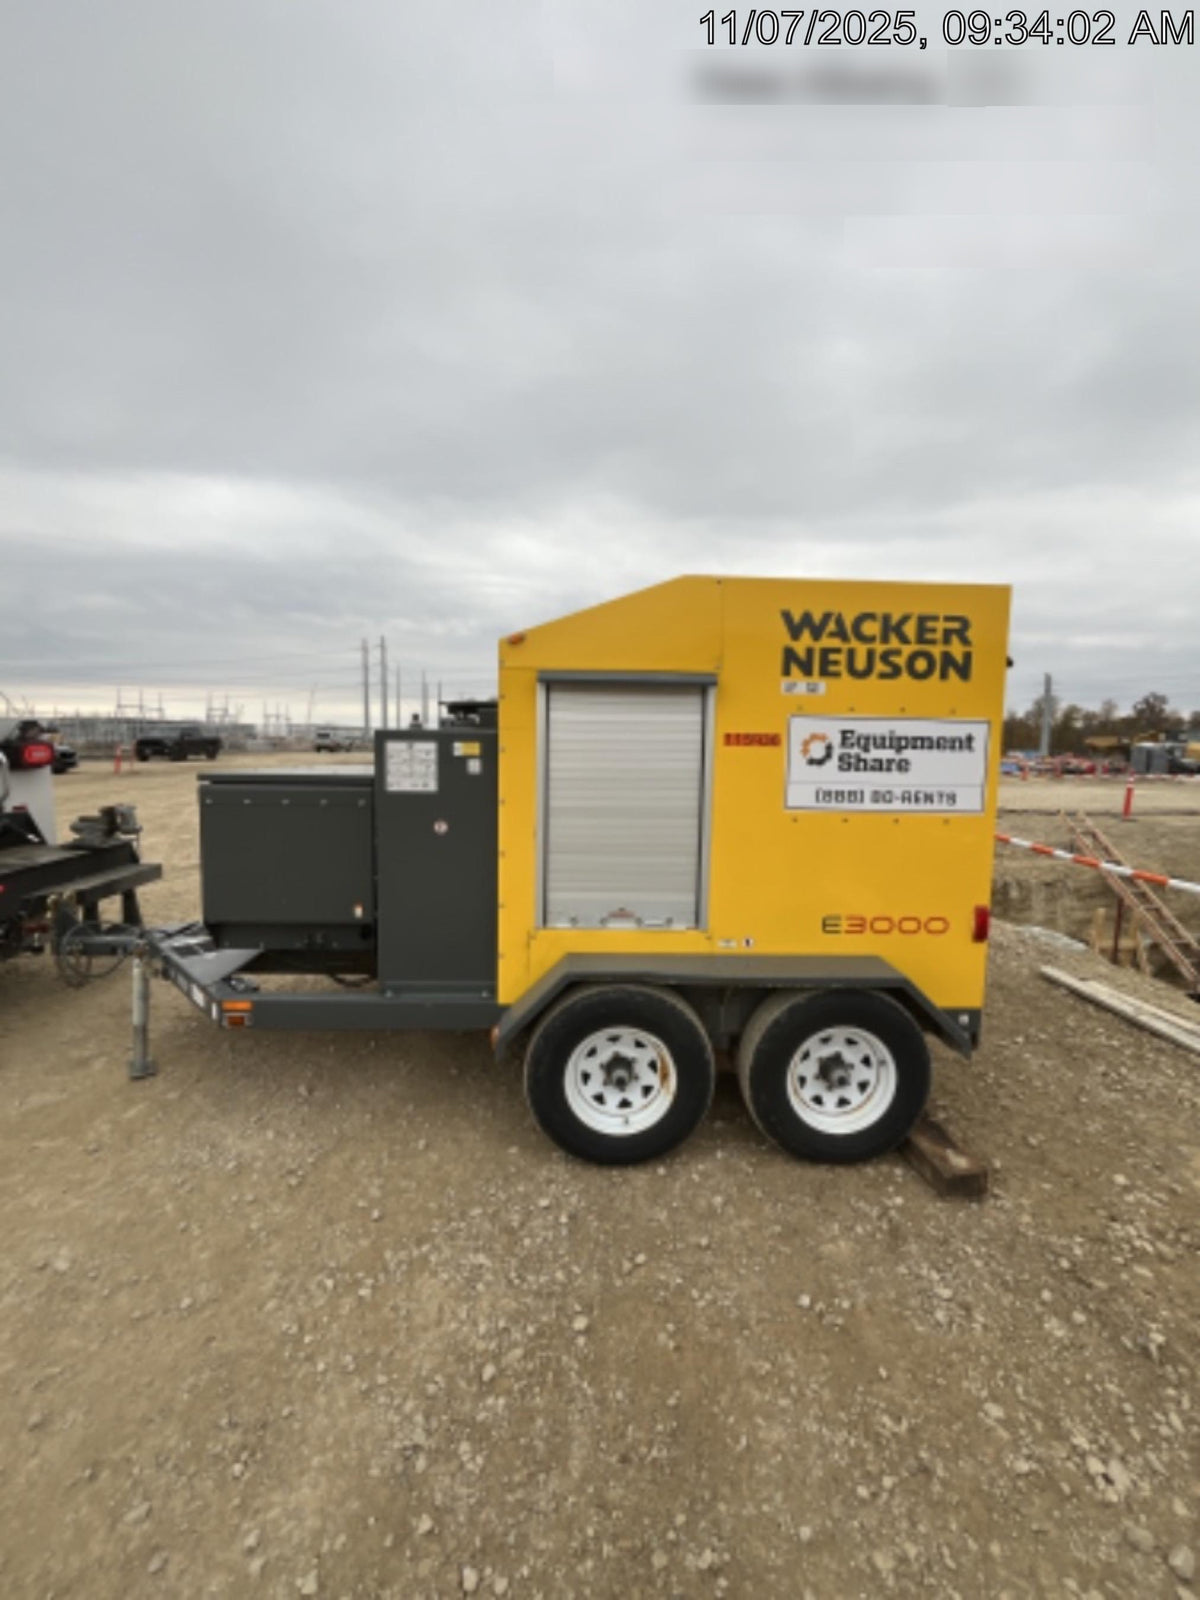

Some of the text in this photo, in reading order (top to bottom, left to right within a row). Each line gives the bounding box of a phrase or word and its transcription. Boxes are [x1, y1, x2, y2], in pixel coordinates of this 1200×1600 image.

[781, 609, 972, 646] WACKER
[781, 645, 972, 682] NEUSON
[838, 729, 975, 753] Equipment
[837, 752, 911, 774] Share
[822, 914, 949, 935] E3000
